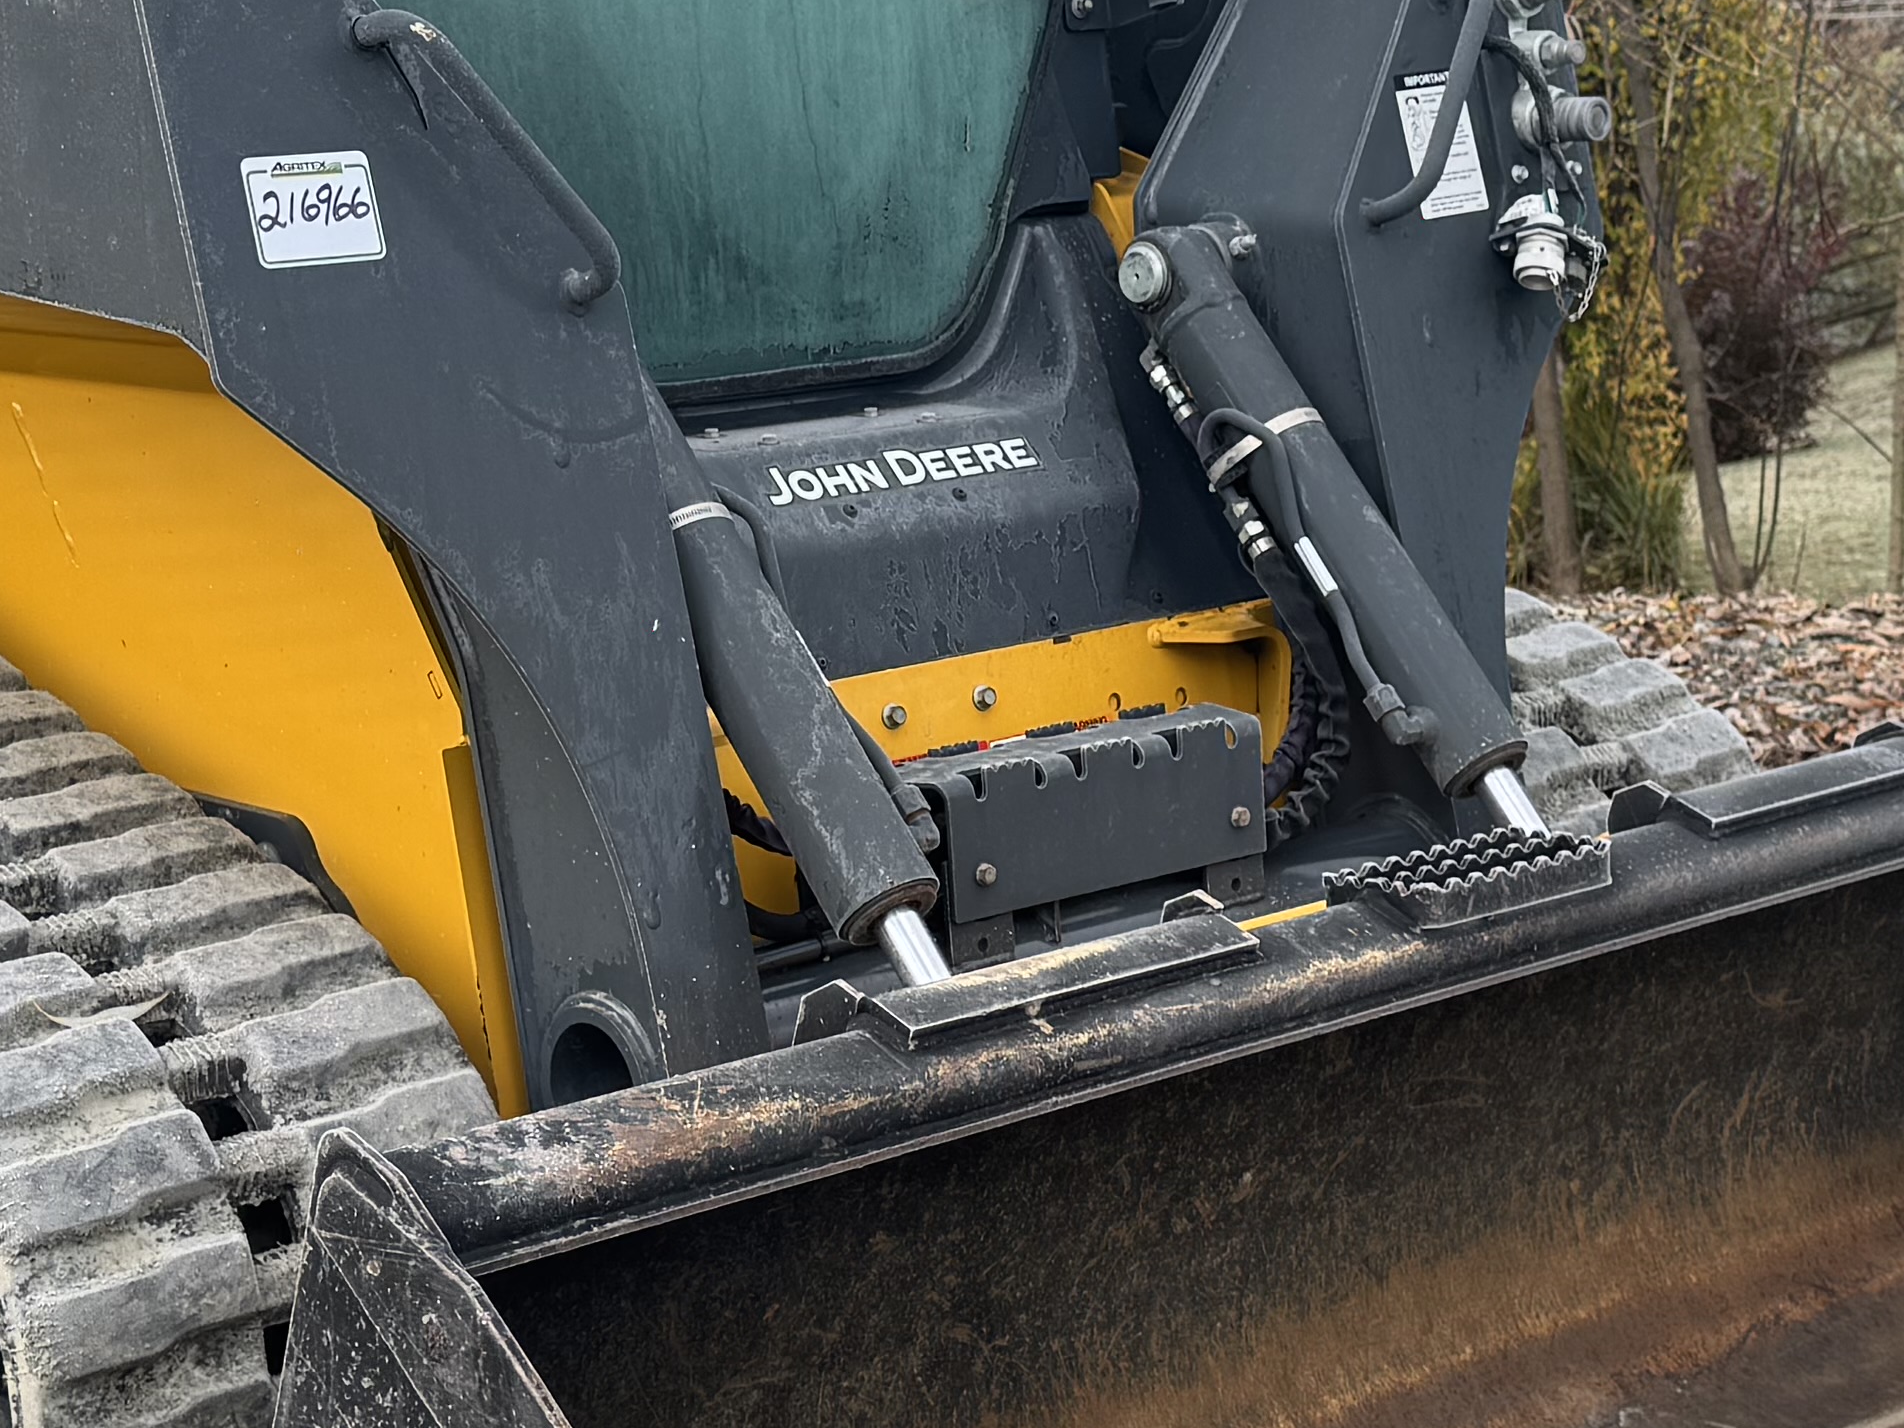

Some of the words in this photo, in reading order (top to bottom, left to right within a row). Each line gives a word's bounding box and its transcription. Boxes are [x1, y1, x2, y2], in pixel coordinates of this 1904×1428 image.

[271, 160, 326, 173] AGRITEX
[257, 182, 371, 233] 216966
[768, 459, 890, 506] JOHN
[882, 437, 1038, 487] DEERE
